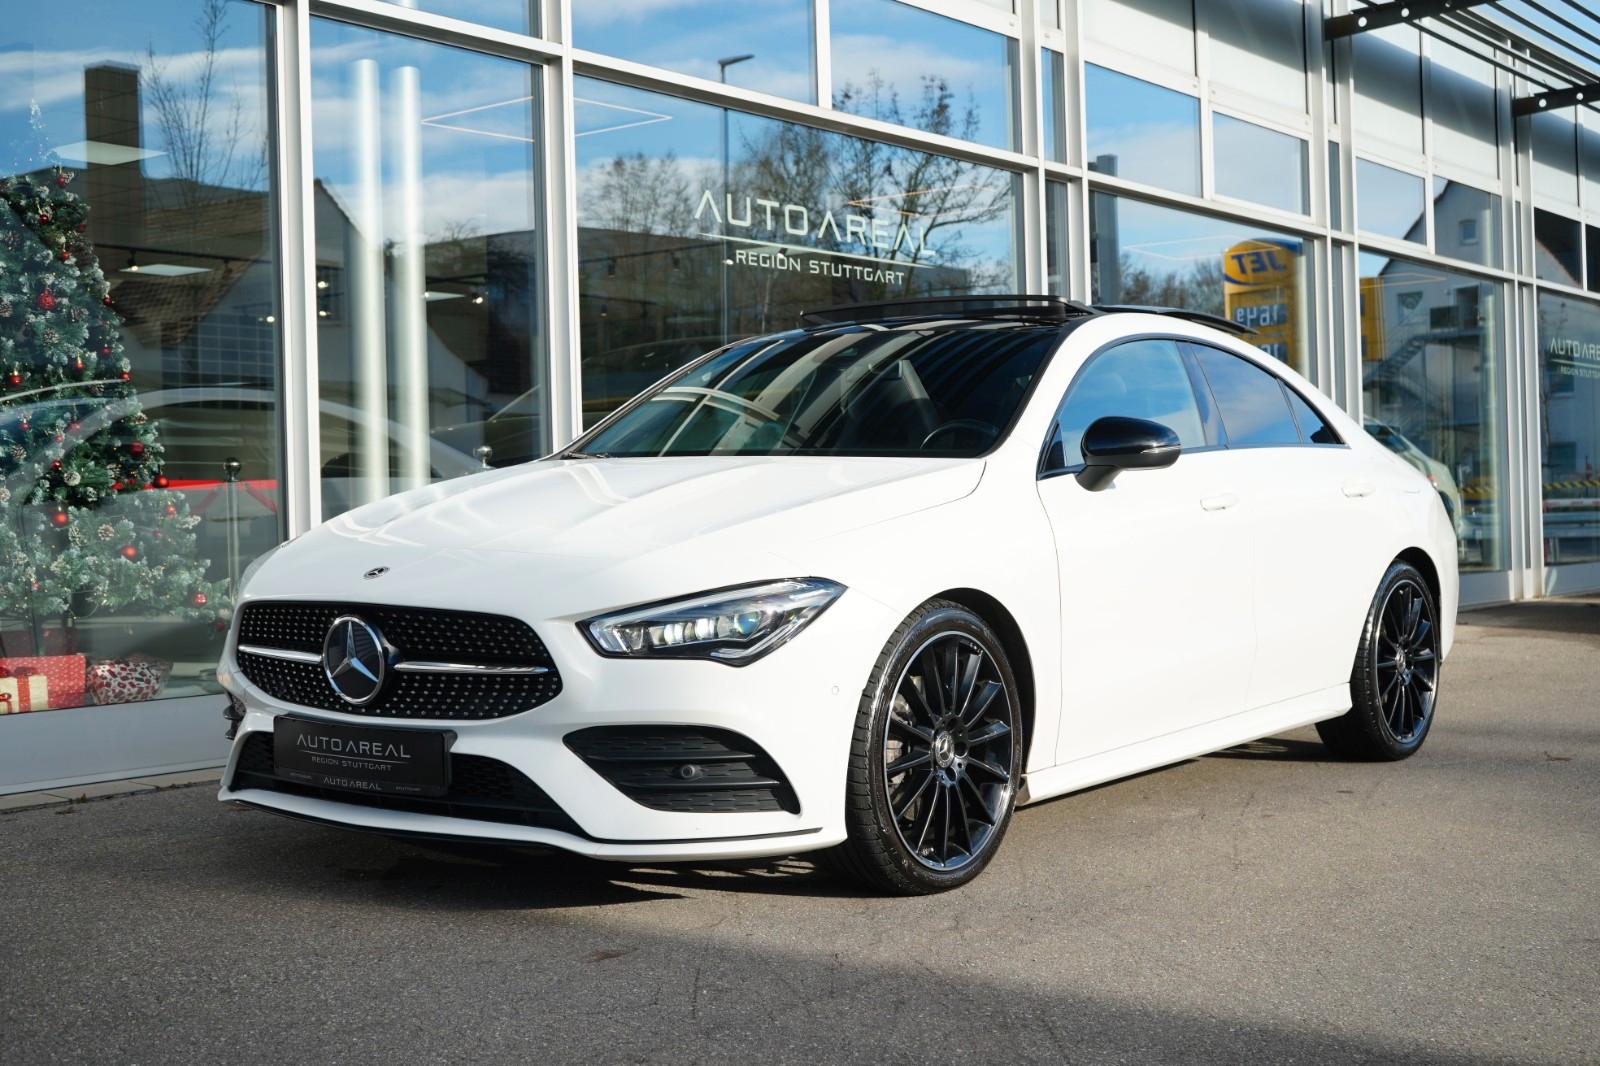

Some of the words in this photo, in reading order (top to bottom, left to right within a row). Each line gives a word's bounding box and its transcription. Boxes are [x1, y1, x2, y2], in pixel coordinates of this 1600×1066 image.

[735, 249, 801, 272] REGION
[809, 259, 905, 285] STUTTGART
[311, 755, 339, 766] REGION
[341, 759, 392, 772] STUTTGART
